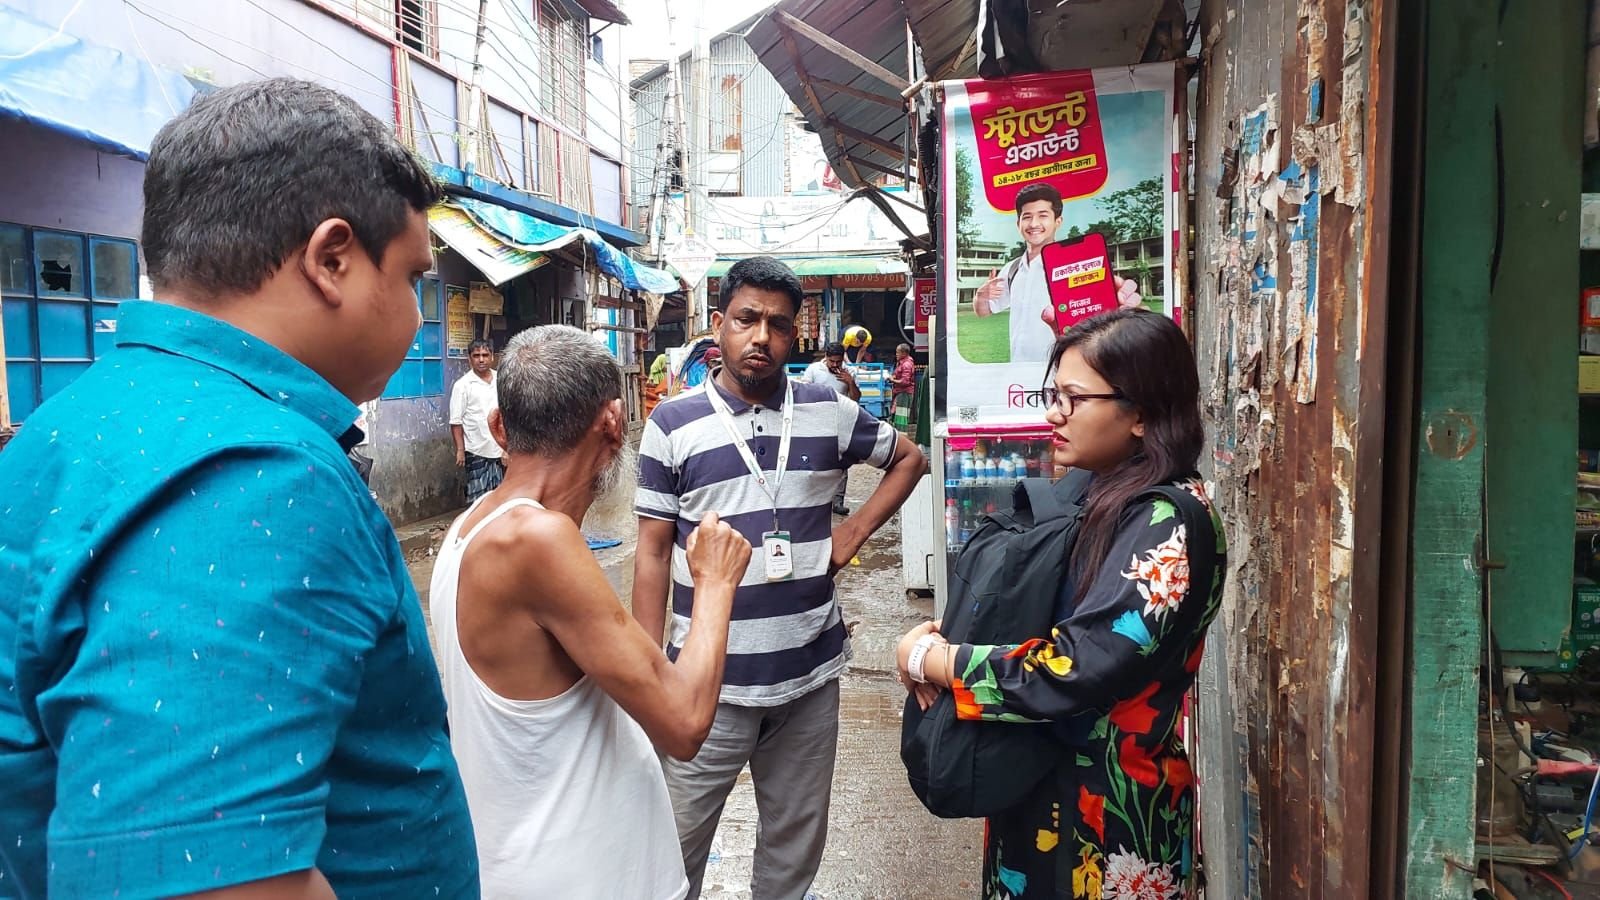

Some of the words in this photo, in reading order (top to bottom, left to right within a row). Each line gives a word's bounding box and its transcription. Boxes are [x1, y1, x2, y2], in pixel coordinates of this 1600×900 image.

[982, 91, 1086, 147] স্টুডেন্ট
[1004, 129, 1079, 166] একাউন্ট
[1023, 168, 1040, 179] বছর
